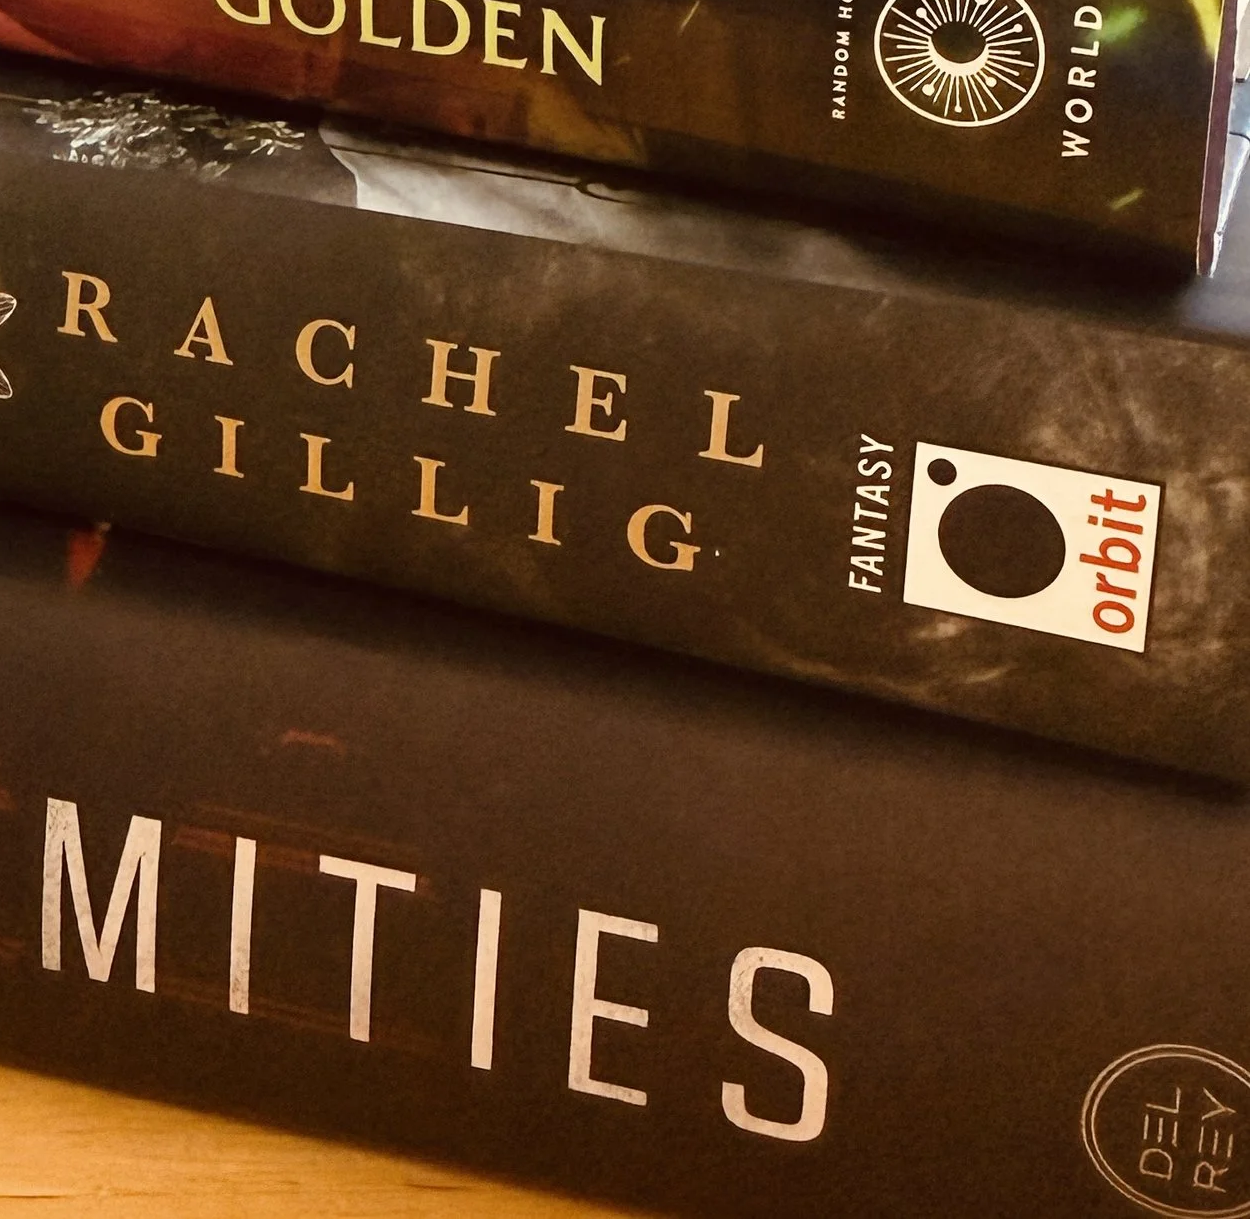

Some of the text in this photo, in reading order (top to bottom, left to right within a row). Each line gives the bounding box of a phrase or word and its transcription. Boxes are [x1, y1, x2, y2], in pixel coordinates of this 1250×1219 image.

[832, 30, 851, 120] RANDOM
[57, 270, 765, 469] RACHEL
[100, 395, 703, 572] GILLIG
[849, 433, 895, 593] FANTASY
[1079, 488, 1147, 634] orbit
[1139, 1086, 1237, 1193] DEL REY
